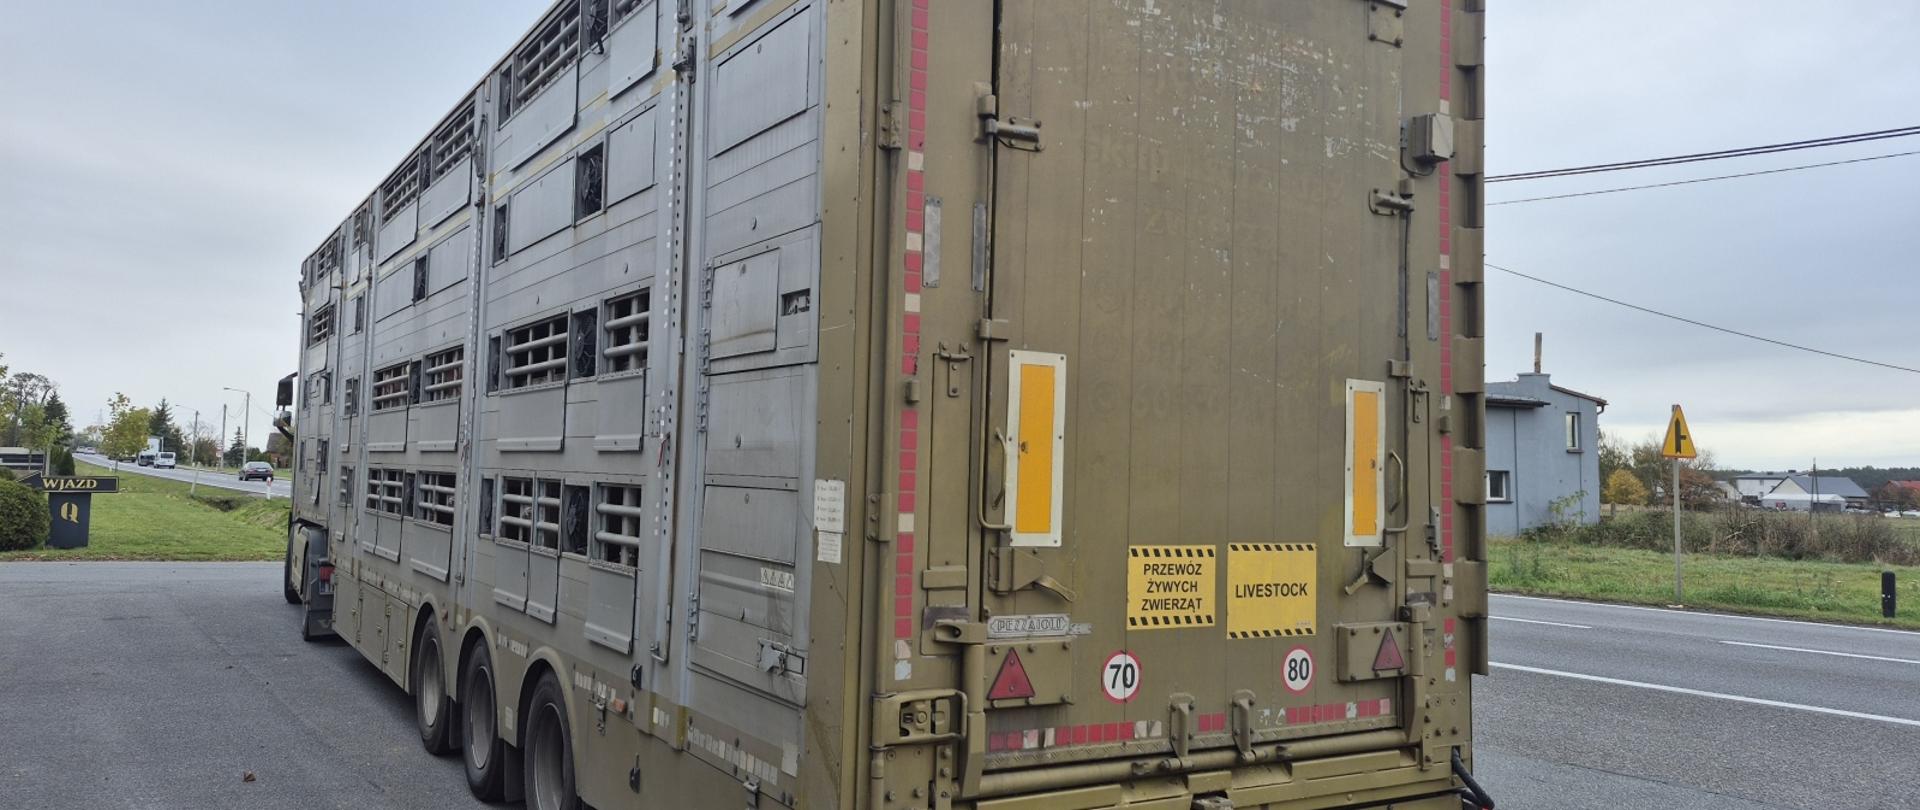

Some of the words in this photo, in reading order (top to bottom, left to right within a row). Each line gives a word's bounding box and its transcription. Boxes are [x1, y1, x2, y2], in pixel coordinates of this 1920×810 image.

[43, 479, 97, 490] WJAZD
[1143, 561, 1202, 576] PRZEWÓZ
[1147, 578, 1198, 593] ŻYWYCH
[1235, 583, 1308, 598] LIVESTOCK
[1142, 598, 1202, 613] ZWIERZĄT
[1109, 663, 1135, 689] 70
[1288, 657, 1310, 681] 80
